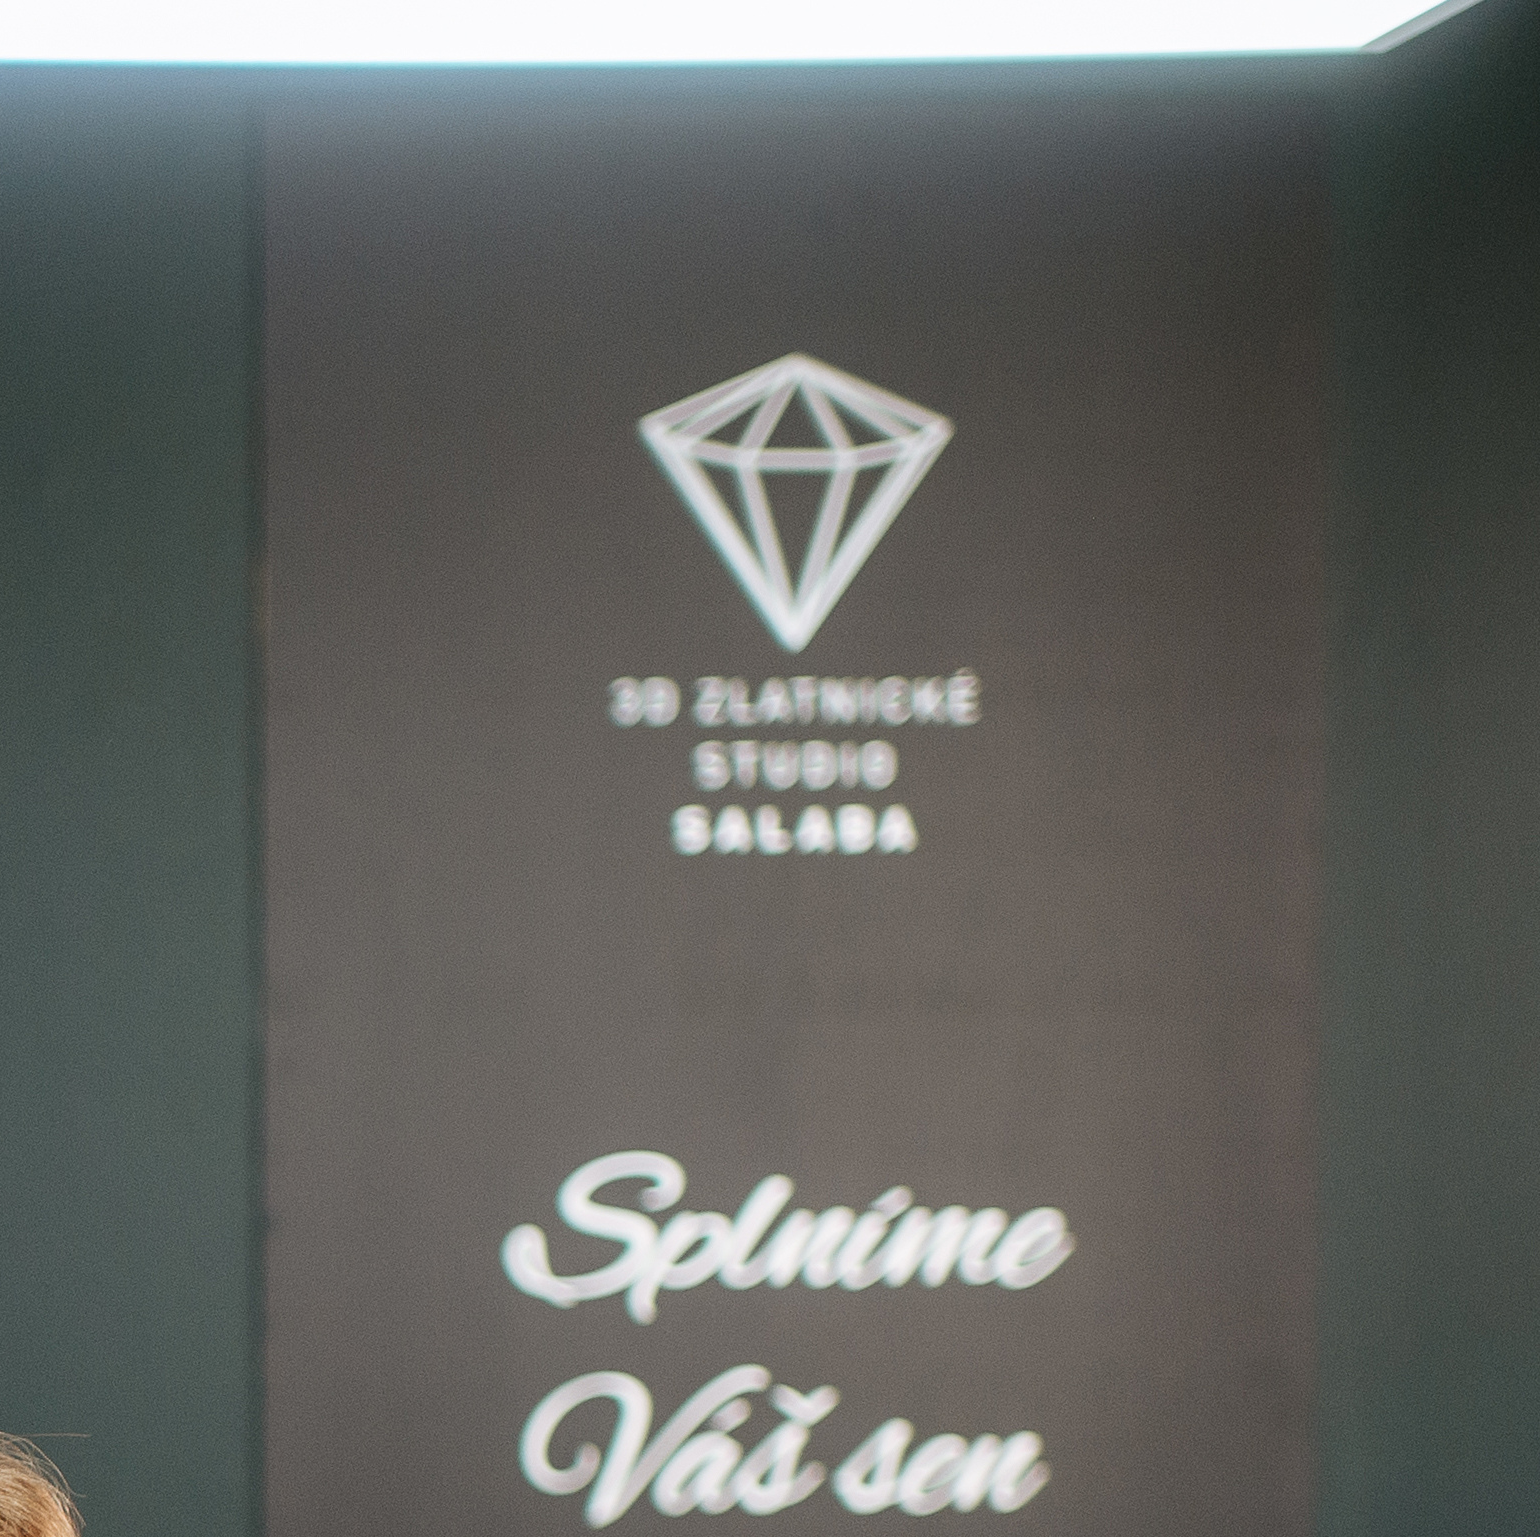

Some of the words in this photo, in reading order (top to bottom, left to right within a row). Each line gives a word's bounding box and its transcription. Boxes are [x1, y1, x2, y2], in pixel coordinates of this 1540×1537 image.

[610, 675, 680, 727] 3D
[693, 668, 982, 727] ZLATNICKÉ
[690, 740, 898, 790] STUDIO
[670, 804, 919, 855] SALABA
[501, 1150, 1075, 1325] Splníme
[521, 1364, 839, 1528] Váš
[834, 1418, 1051, 1516] sen
